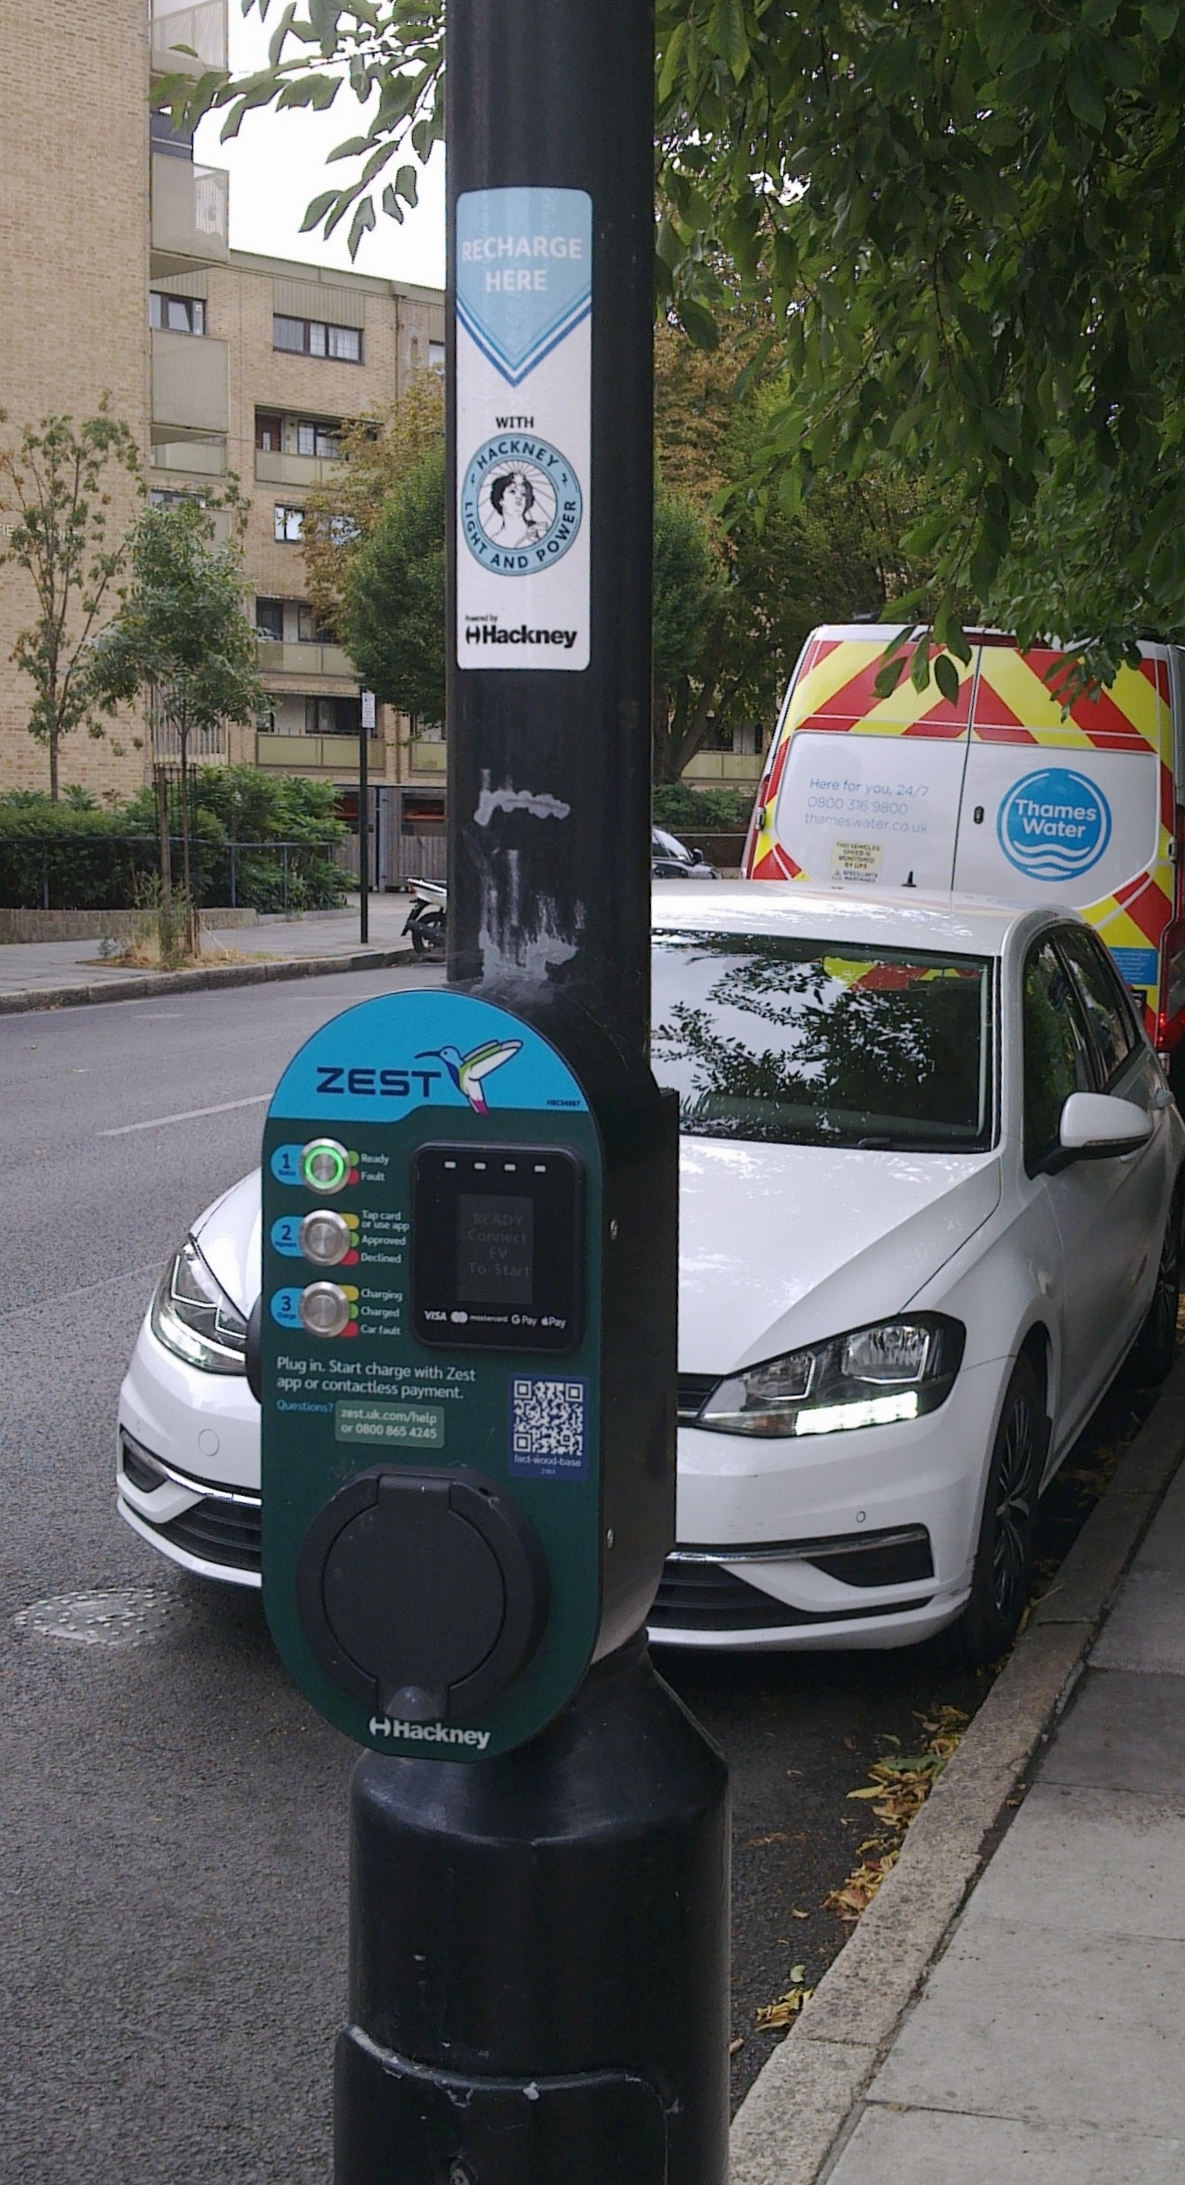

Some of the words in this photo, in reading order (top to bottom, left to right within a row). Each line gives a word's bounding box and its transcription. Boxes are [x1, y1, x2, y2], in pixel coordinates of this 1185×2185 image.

[462, 236, 582, 261] RECHARGE
[485, 270, 547, 292] HERE
[495, 416, 534, 428] WITH
[477, 440, 559, 469] HACKNEY
[464, 502, 488, 555] LIGHT
[490, 554, 528, 569] AND
[537, 500, 576, 562] POWER
[490, 615, 498, 623] by
[482, 624, 577, 649] Hackney
[809, 778, 839, 791] Here
[843, 780, 861, 792] for
[865, 785, 892, 796] you,
[896, 784, 929, 798] 24/7
[807, 796, 844, 810] 0800
[847, 799, 868, 812] 316
[872, 801, 908, 815] 9800
[1015, 799, 1097, 821] Thames
[805, 813, 928, 834] thameswater.co.uk
[1023, 817, 1086, 838] Water
[316, 1066, 442, 1098] ZEST
[282, 1153, 291, 1169] 1
[361, 1153, 389, 1166] Ready
[361, 1171, 385, 1181] Fault
[362, 1210, 378, 1221] Tap
[380, 1212, 401, 1221] card
[473, 1213, 525, 1227] READY
[281, 1225, 291, 1240] 2
[361, 1221, 372, 1229] or
[374, 1221, 391, 1229] use
[392, 1222, 410, 1232] app
[361, 1235, 406, 1246] Approved
[467, 1229, 527, 1243] Connect
[361, 1252, 402, 1263] Declined
[489, 1246, 508, 1259] EV
[467, 1262, 486, 1275] To
[495, 1263, 530, 1277] Start
[361, 1288, 403, 1302] Charging
[281, 1296, 291, 1311] 3
[361, 1306, 400, 1319] Charged
[424, 1310, 447, 1321] VISA
[469, 1315, 508, 1323] mastercard
[511, 1314, 521, 1325] G
[522, 1315, 538, 1328] Pay
[361, 1324, 377, 1334] Car
[379, 1325, 401, 1335] fault
[277, 1356, 307, 1374] Plug
[309, 1358, 325, 1372] in.
[329, 1360, 361, 1374] Start
[365, 1362, 411, 1379] charge
[414, 1365, 443, 1379] with
[446, 1366, 476, 1382] Zest
[276, 1377, 302, 1392] app
[304, 1379, 319, 1389] or
[322, 1379, 398, 1395] contactless
[401, 1385, 464, 1400] payment.
[276, 1399, 333, 1413] Questions?
[341, 1408, 437, 1426] zest.uk.com/help
[341, 1424, 353, 1433] or
[356, 1423, 383, 1435] 0800
[386, 1425, 407, 1437] 865
[409, 1426, 437, 1439] 4245
[514, 1454, 581, 1467] fact-wood-base
[393, 1719, 491, 1750] Hackney
